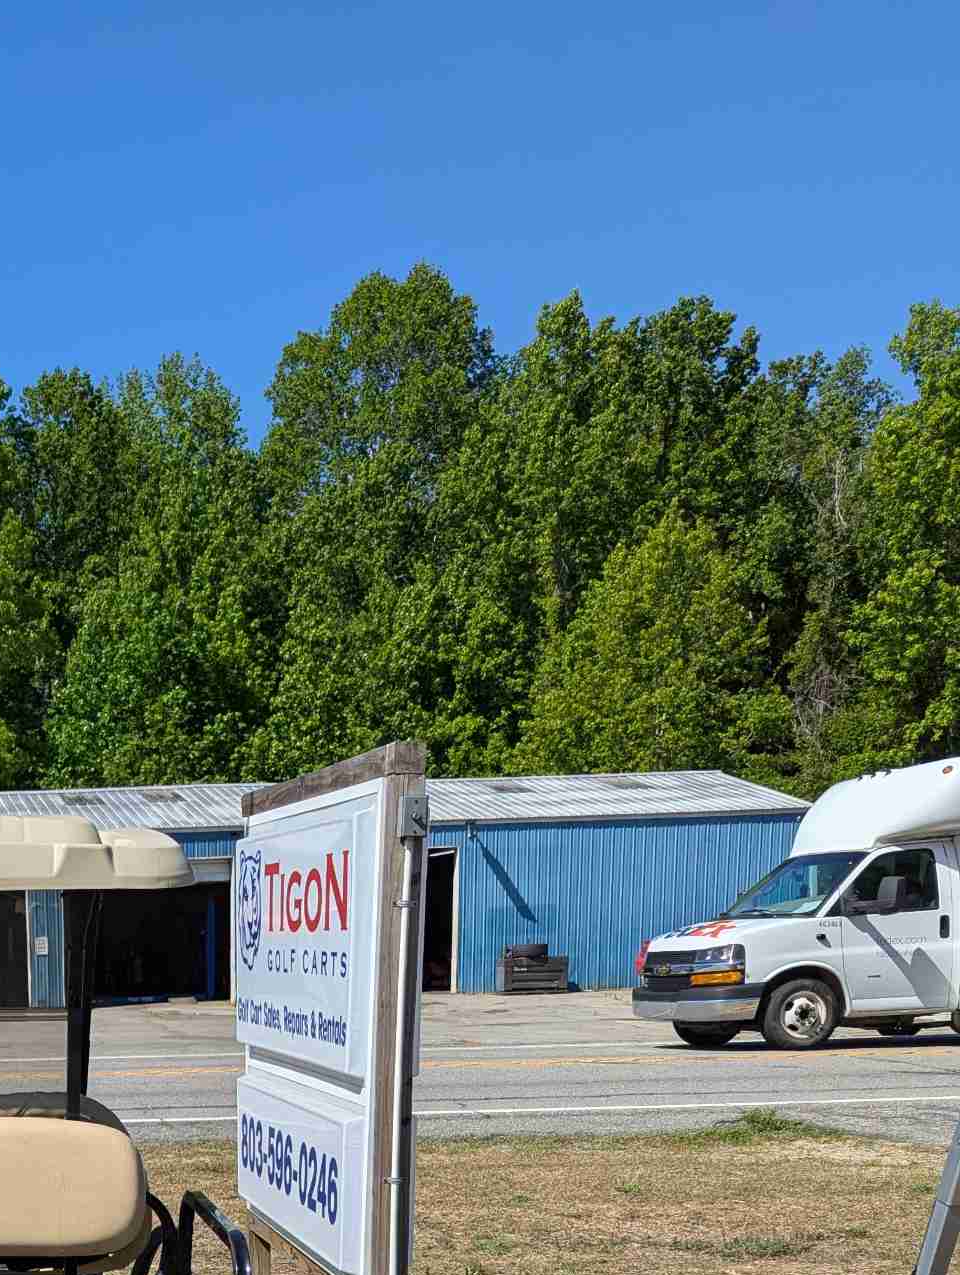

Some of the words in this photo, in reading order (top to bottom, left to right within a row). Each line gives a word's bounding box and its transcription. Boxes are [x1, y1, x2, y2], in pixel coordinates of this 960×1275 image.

[264, 850, 349, 933] TIGON
[267, 949, 296, 973] GOLF
[302, 949, 348, 978] CARTS
[874, 934, 928, 945] edex.com
[237, 997, 249, 1022] Golf
[250, 999, 263, 1025] Cart
[263, 1000, 282, 1032] Sales,
[283, 1004, 309, 1039] Repairs
[310, 1009, 317, 1039] &
[318, 1011, 347, 1048] Rentals
[241, 1113, 338, 1225] 803-596-0246
